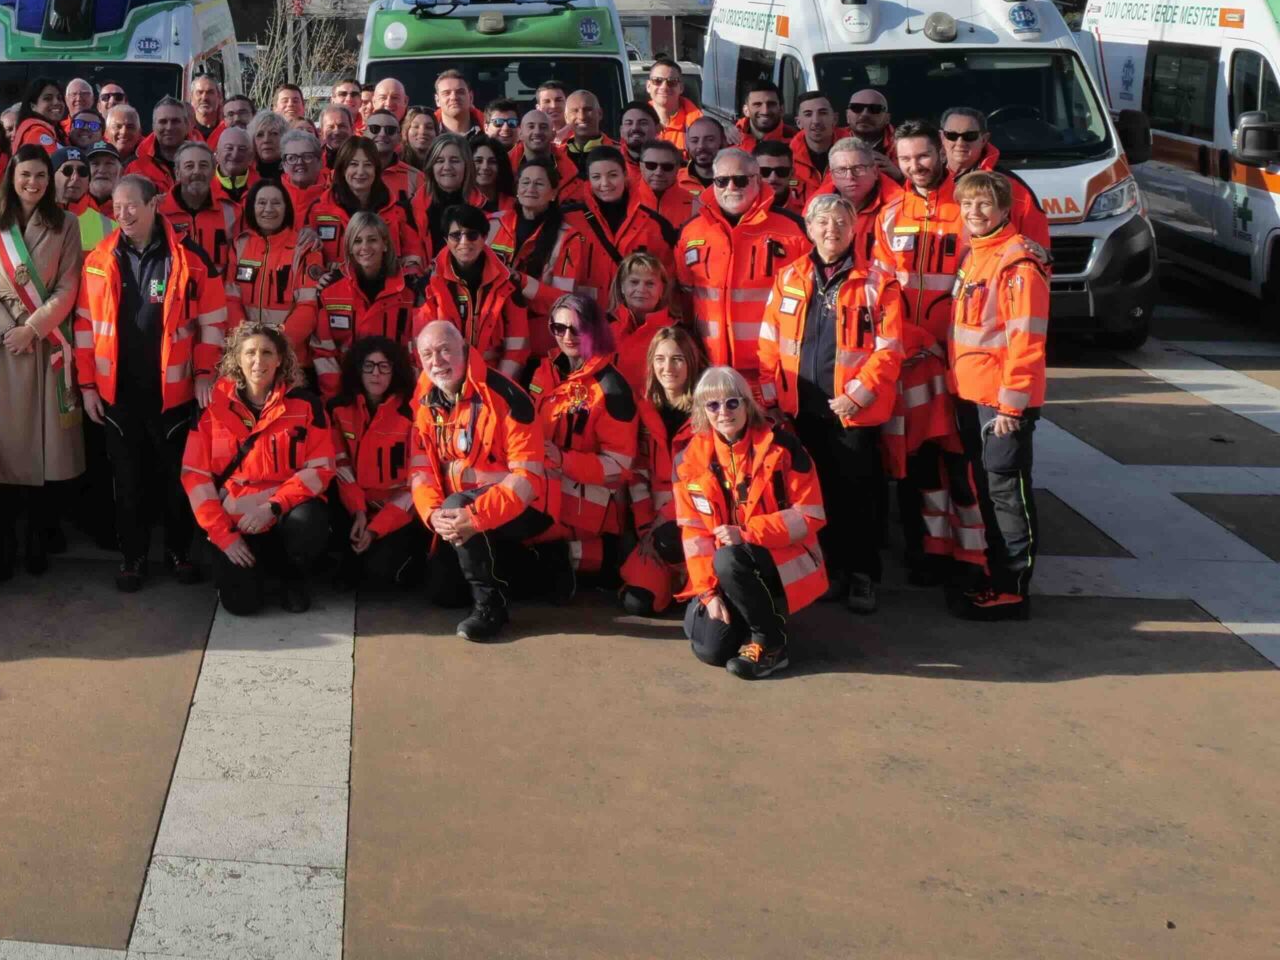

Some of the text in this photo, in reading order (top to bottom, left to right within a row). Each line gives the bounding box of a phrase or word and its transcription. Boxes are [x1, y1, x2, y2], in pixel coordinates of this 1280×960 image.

[1012, 9, 1032, 21] 118
[1104, 1, 1118, 18] ODV
[1120, 3, 1149, 21] CROCE
[1151, 4, 1177, 23] VERDE
[1179, 7, 1219, 27] MESTRE
[581, 24, 597, 34] 118
[140, 41, 158, 49] 118
